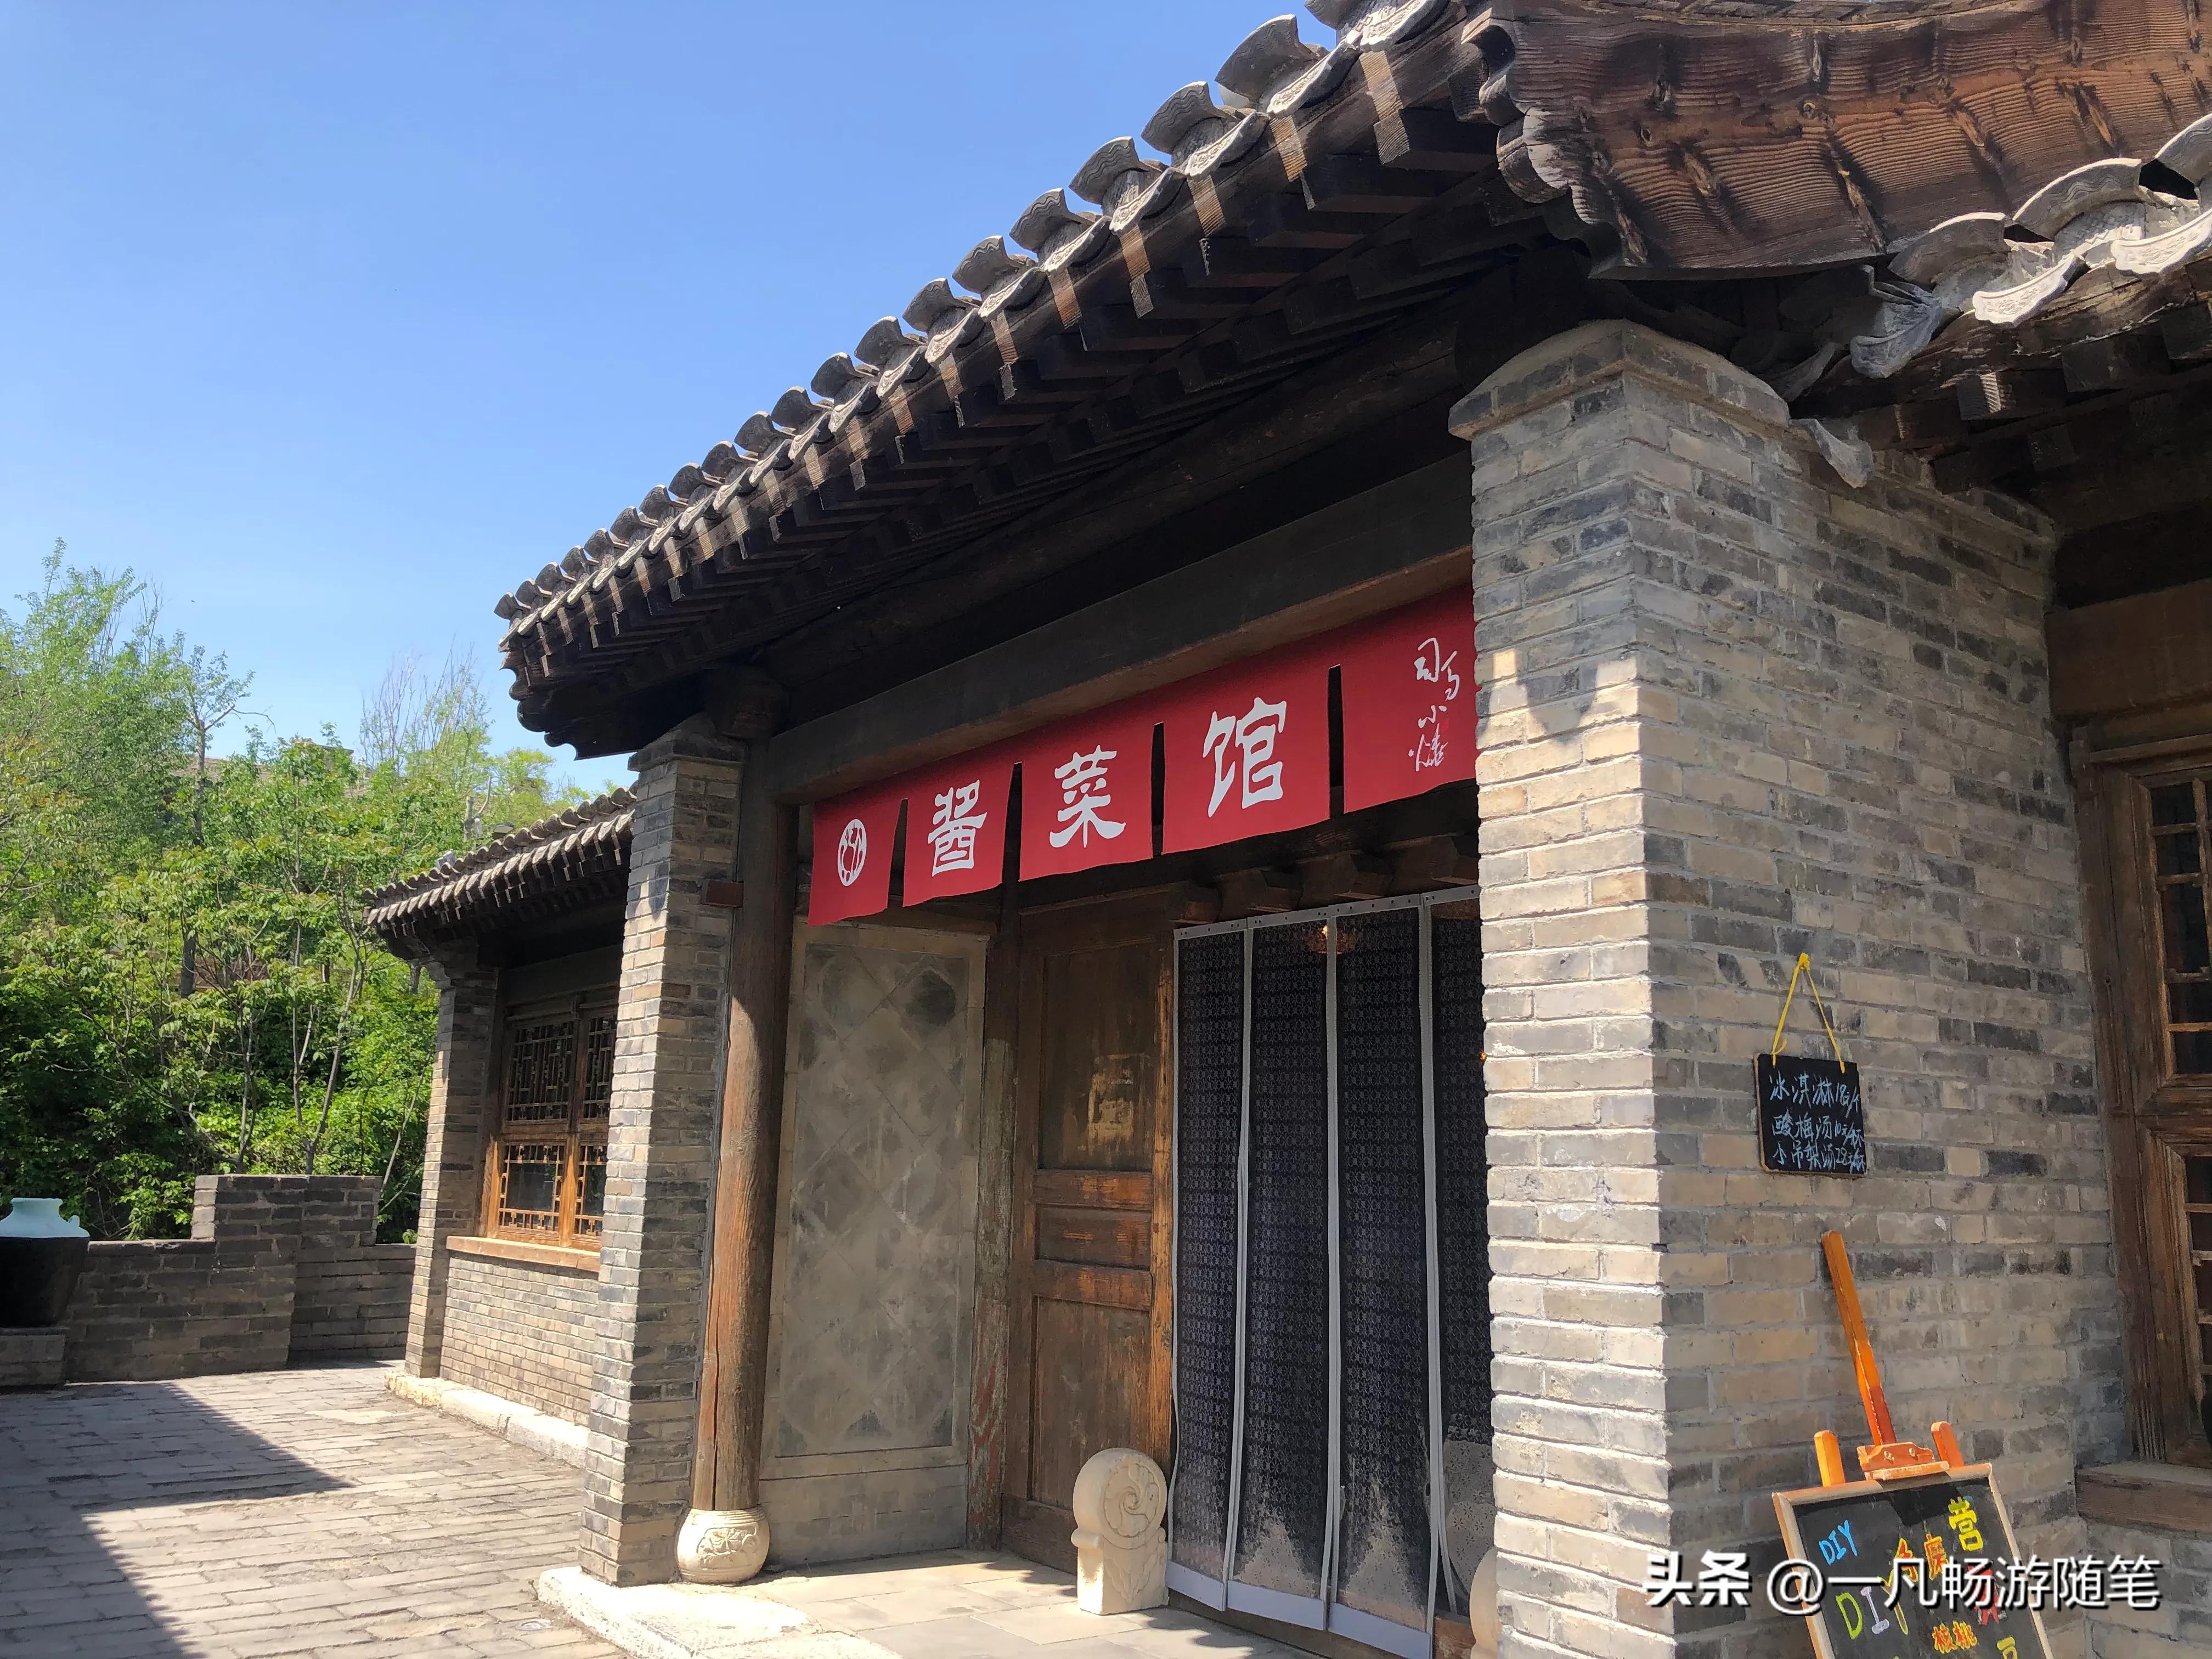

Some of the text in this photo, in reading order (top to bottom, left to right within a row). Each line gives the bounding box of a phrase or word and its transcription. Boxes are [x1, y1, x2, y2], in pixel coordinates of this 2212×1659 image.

[928, 697, 1287, 877] 酱菜馆
[1819, 1519, 1857, 1566] DIY
